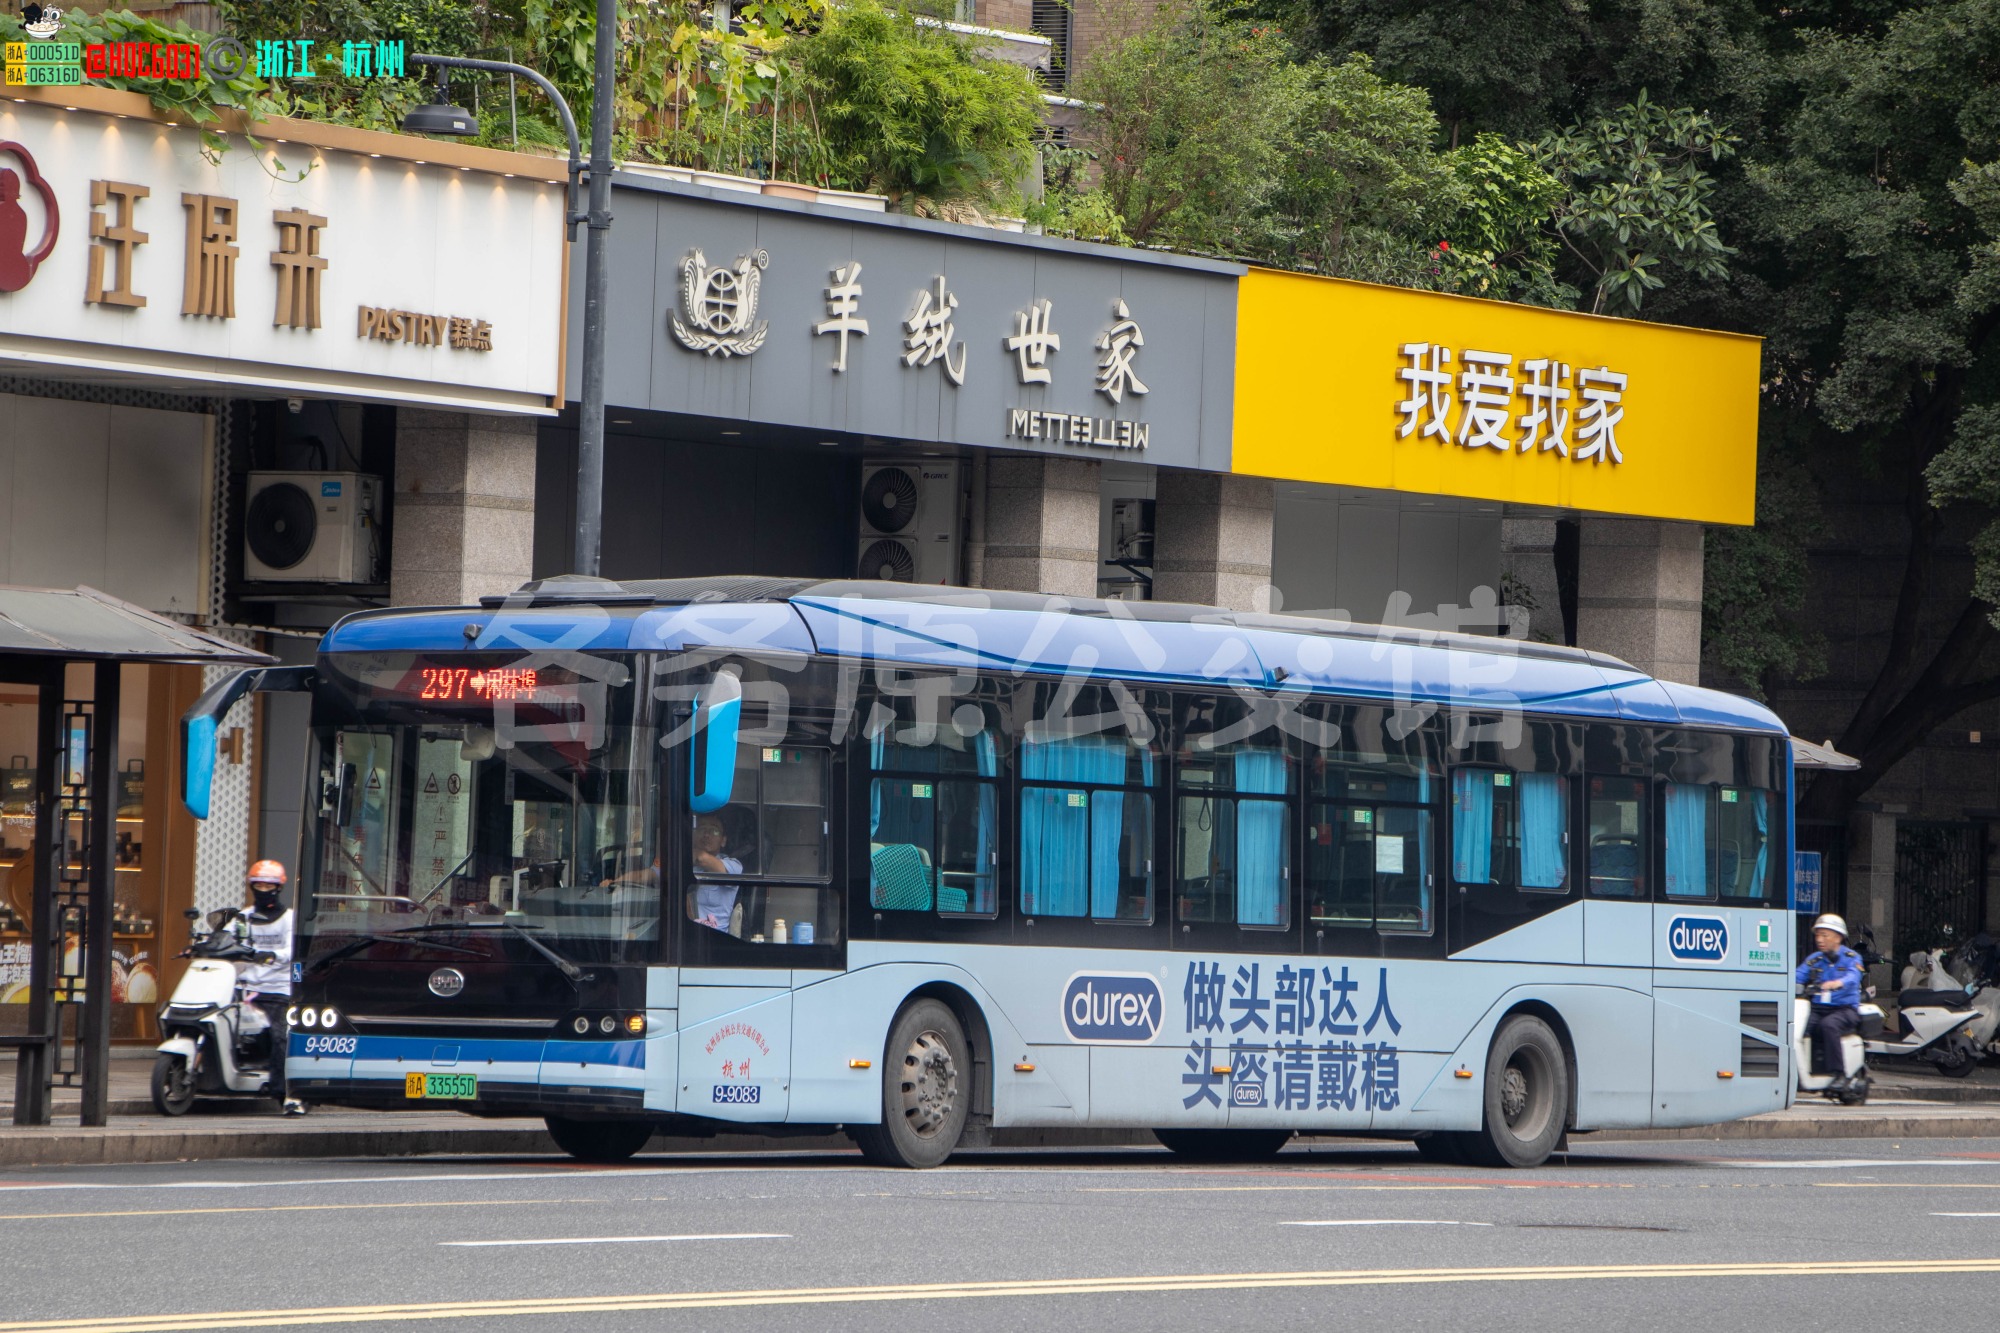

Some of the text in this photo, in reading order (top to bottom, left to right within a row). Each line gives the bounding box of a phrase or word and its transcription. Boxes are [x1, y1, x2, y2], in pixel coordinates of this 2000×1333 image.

[357, 305, 493, 352] PASTRY 糕点
[812, 261, 1150, 404] 羊绒世家
[1395, 342, 1628, 464] 我爱我家
[421, 669, 469, 699] 297
[485, 668, 537, 699] 闲林埠
[1795, 888, 1818, 902] 止占用
[1673, 921, 1725, 957] durex
[1071, 981, 1157, 1037] durex
[1183, 961, 1402, 1038] 做头部达人
[305, 1037, 357, 1053] 9-9083
[721, 1058, 751, 1080] 杭州
[1182, 1038, 1400, 1111] 头盔请戴稳
[714, 1085, 759, 1103] 9-9083
[1236, 1087, 1260, 1101] durex
